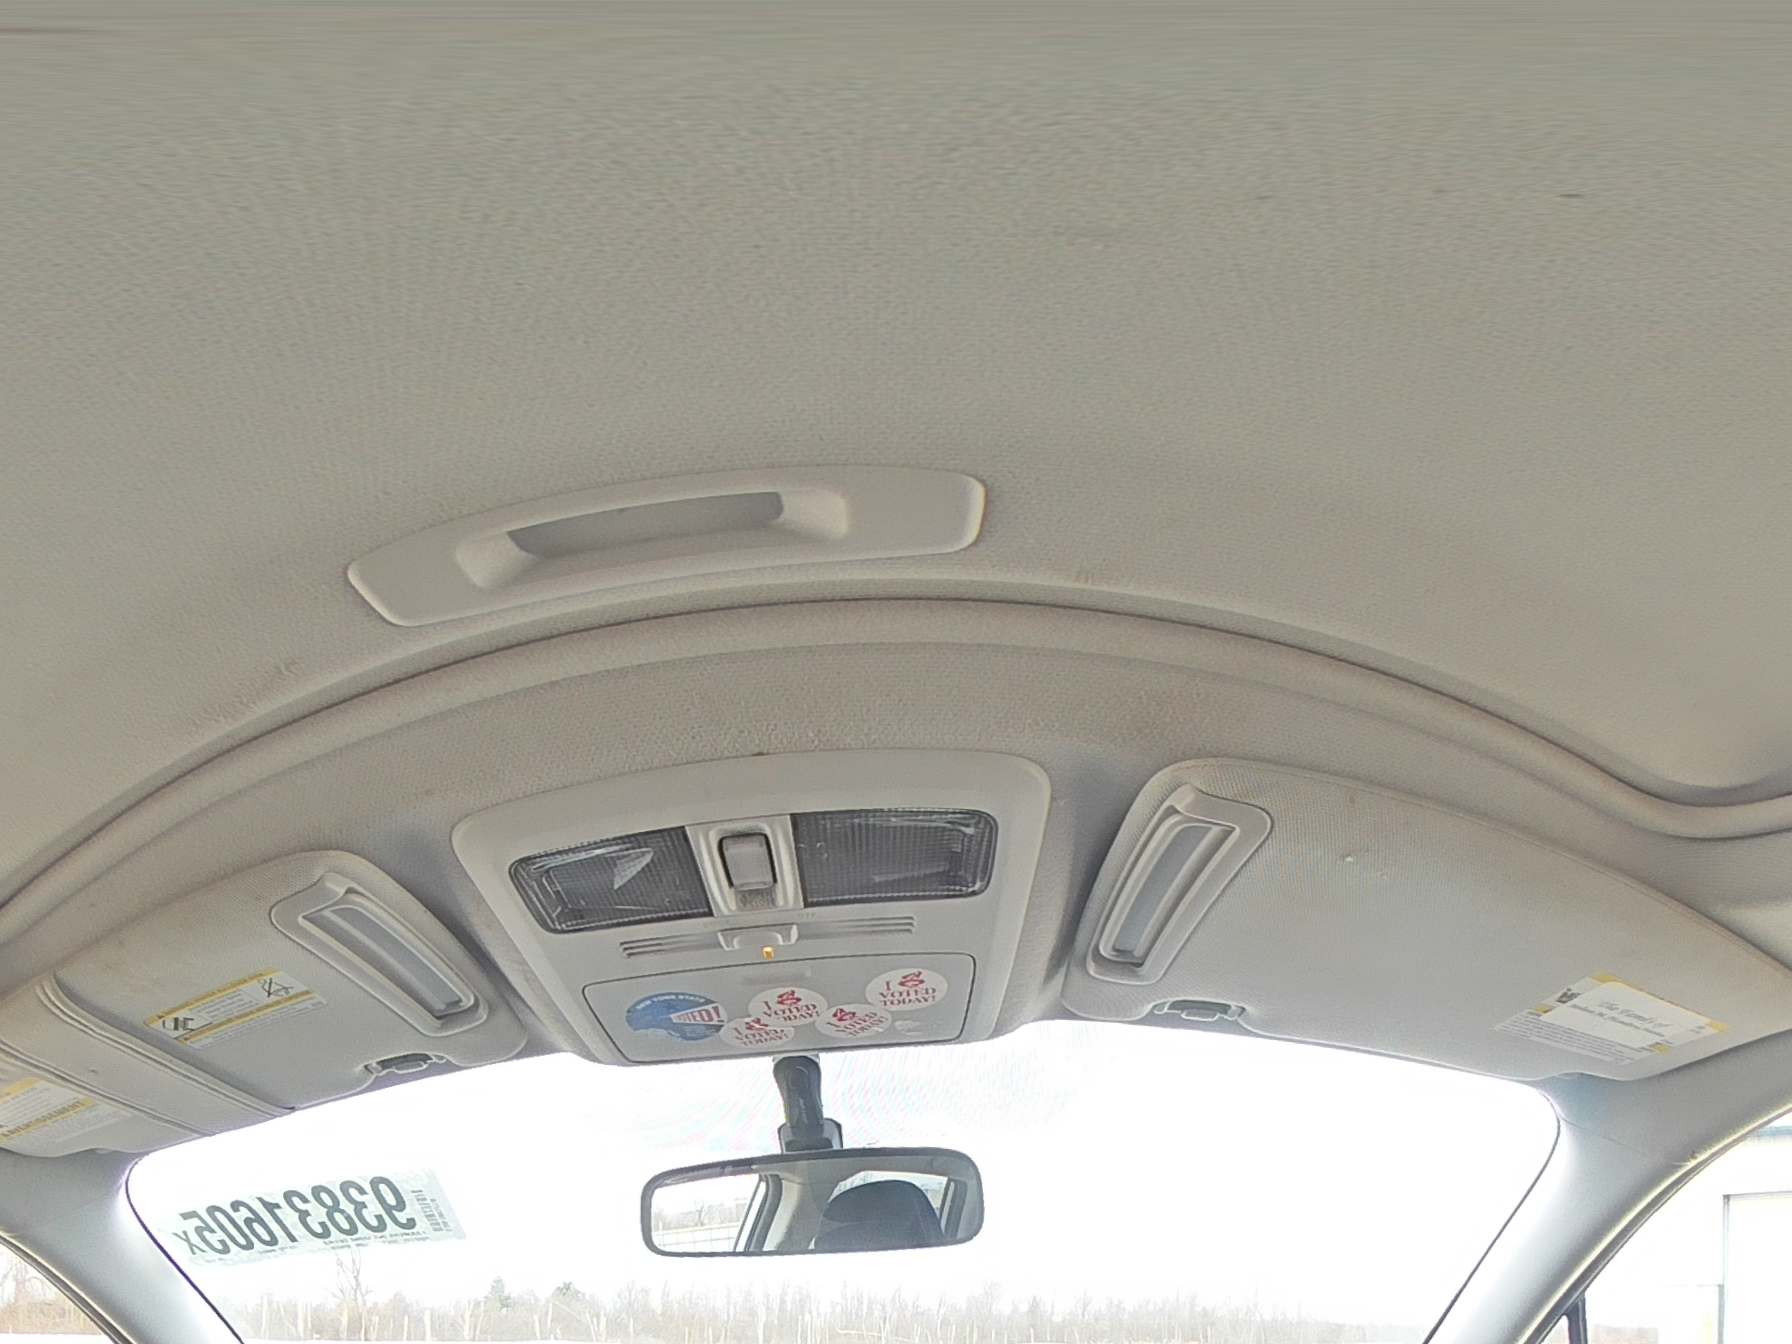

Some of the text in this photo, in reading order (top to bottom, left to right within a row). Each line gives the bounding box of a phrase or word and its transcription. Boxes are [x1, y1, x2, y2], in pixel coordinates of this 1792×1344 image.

[885, 980, 892, 991] I
[878, 987, 937, 999] VOTED
[762, 1000, 772, 1011] I
[879, 995, 937, 1007] TODAY!
[762, 1003, 817, 1018] VOTED
[835, 1011, 877, 1033] VOTED
[733, 1026, 742, 1036] I
[739, 1034, 789, 1047] TODAY!
